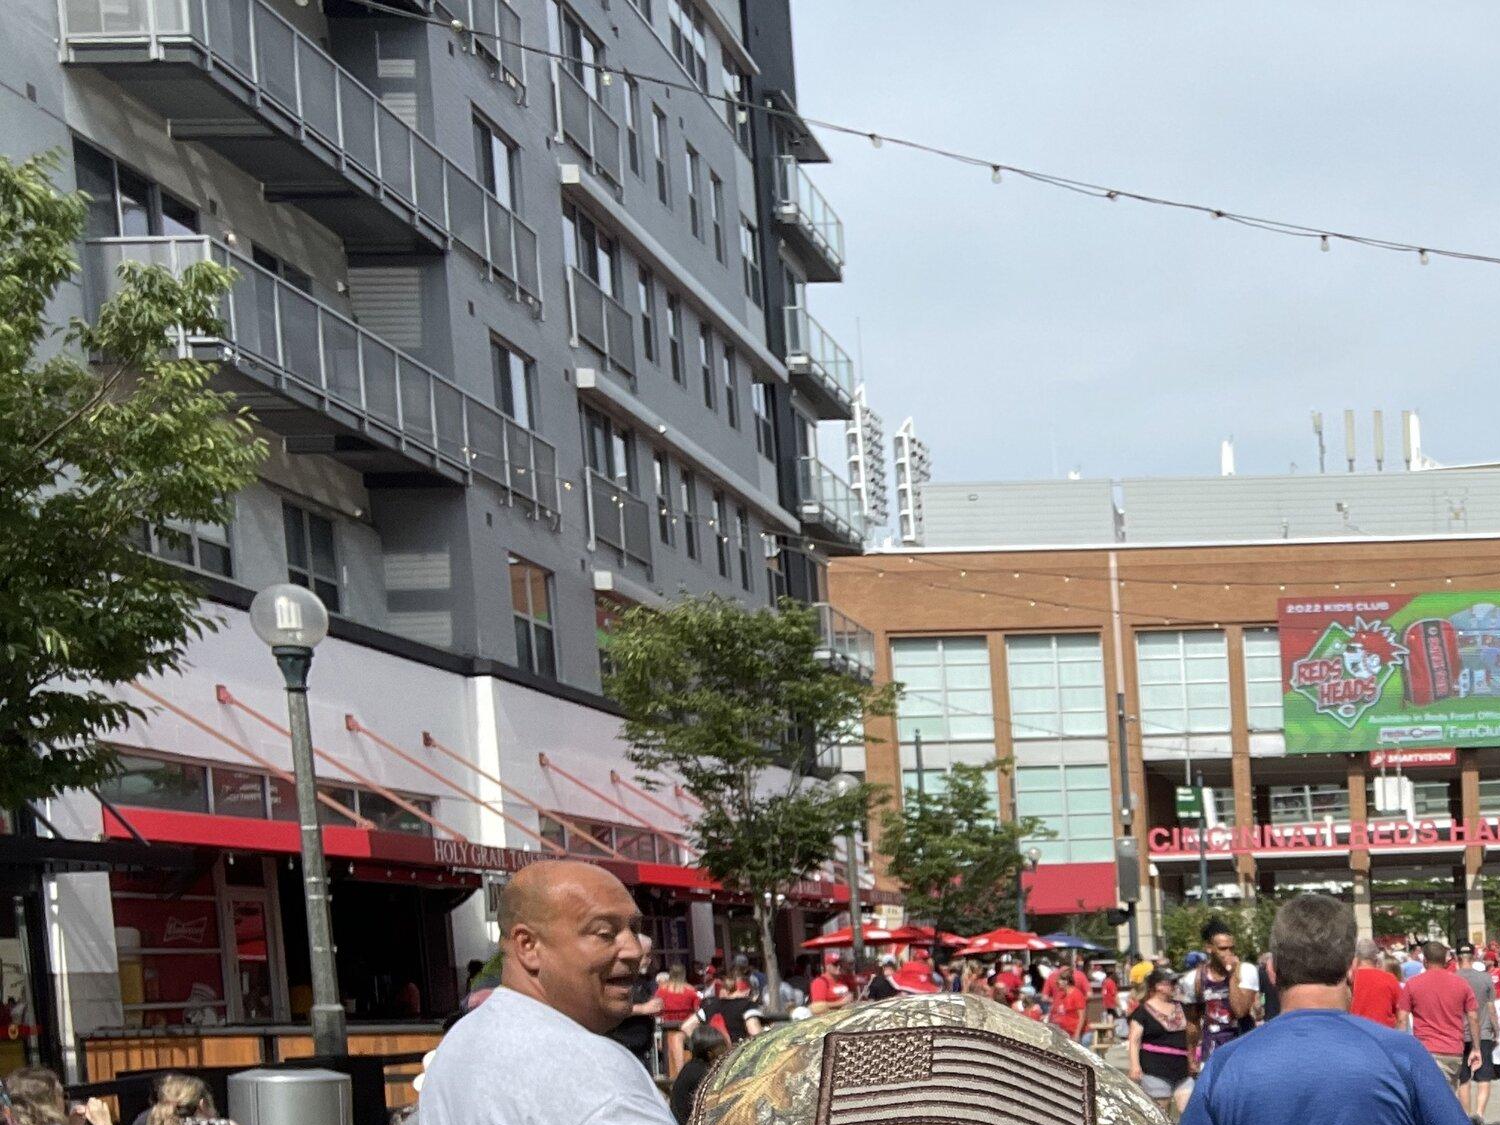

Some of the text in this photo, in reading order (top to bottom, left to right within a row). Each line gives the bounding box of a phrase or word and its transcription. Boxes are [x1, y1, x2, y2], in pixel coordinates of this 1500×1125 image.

[1286, 601, 1389, 613] 2022 KIDS CLUB
[1298, 658, 1342, 684] REDS
[1318, 676, 1377, 706] HEADS
[1149, 822, 1338, 851] CINCINNATI
[1350, 818, 1438, 849] REDS
[434, 839, 469, 864] HOLY
[471, 843, 507, 867] GRAIL
